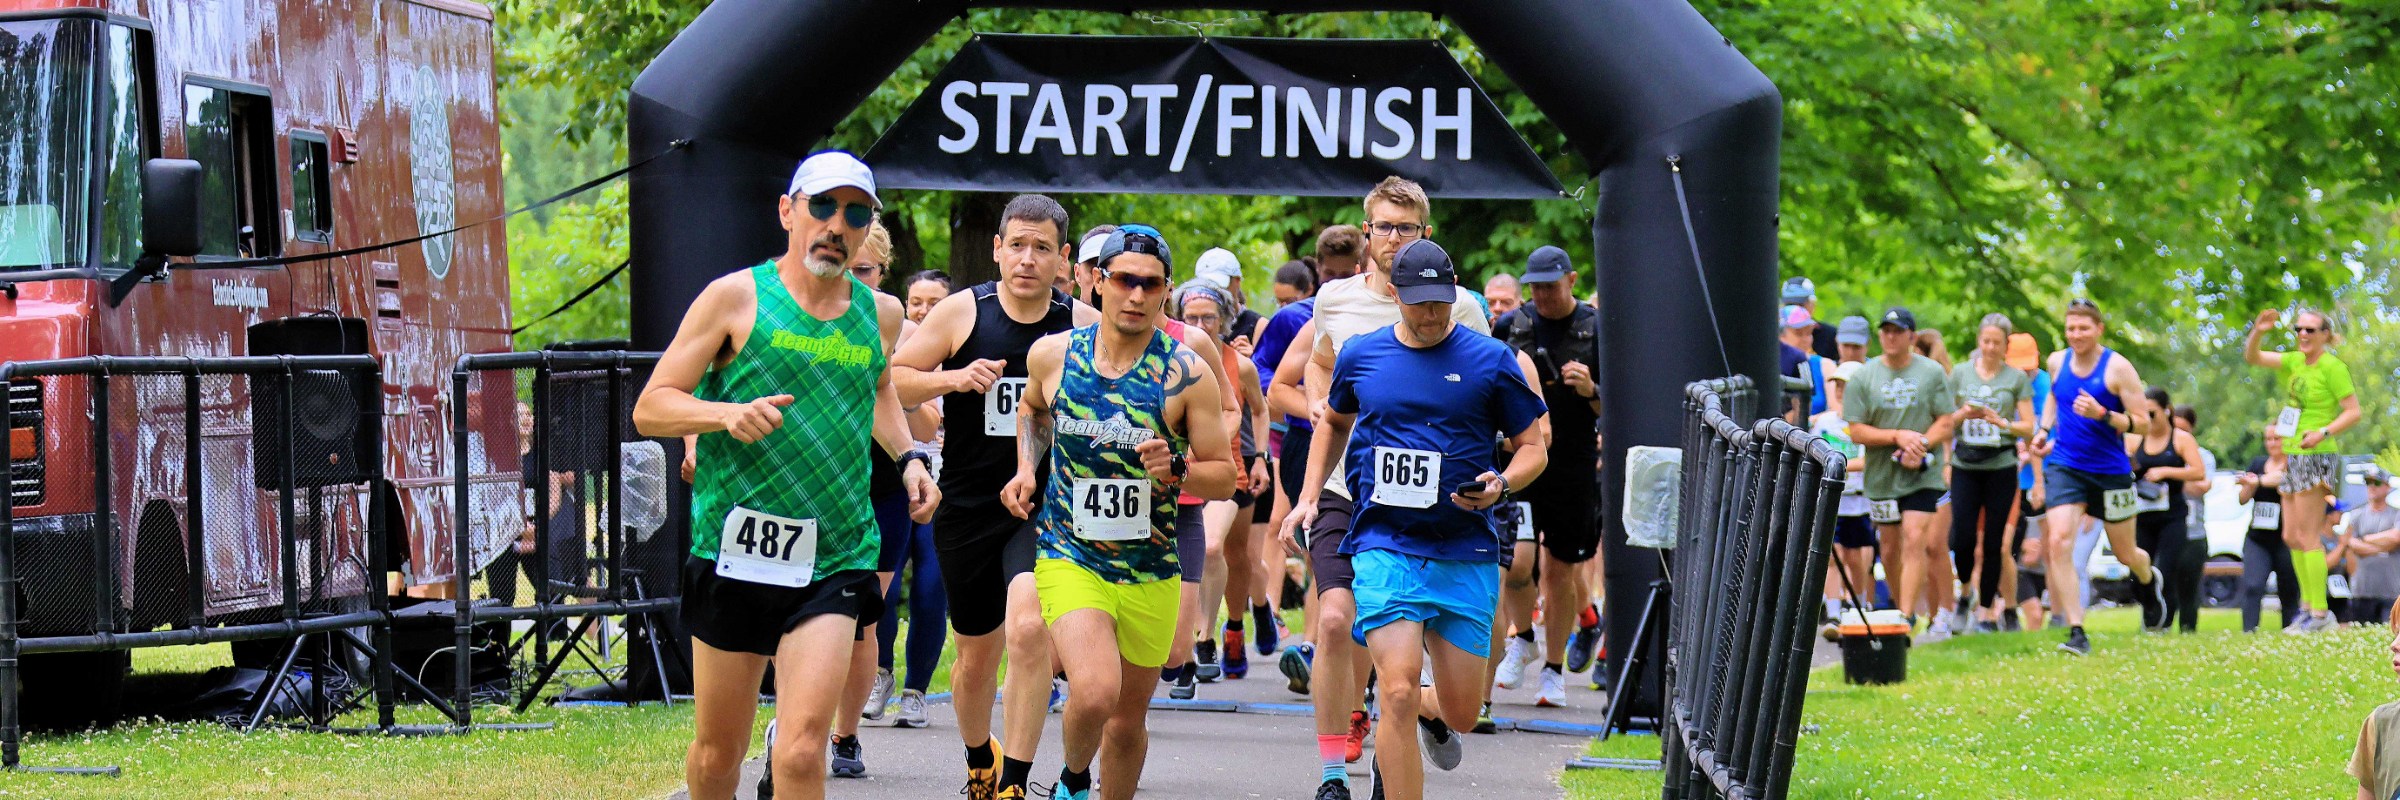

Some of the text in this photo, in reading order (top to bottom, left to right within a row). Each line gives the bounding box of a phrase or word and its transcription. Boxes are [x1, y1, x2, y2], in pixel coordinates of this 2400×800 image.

[939, 74, 1471, 172] START/FINISH
[771, 329, 823, 354] Team
[1057, 415, 1155, 446] Team GFR
[1382, 452, 1430, 488] 665
[1084, 483, 1140, 519] 436
[736, 515, 804, 562] 487
